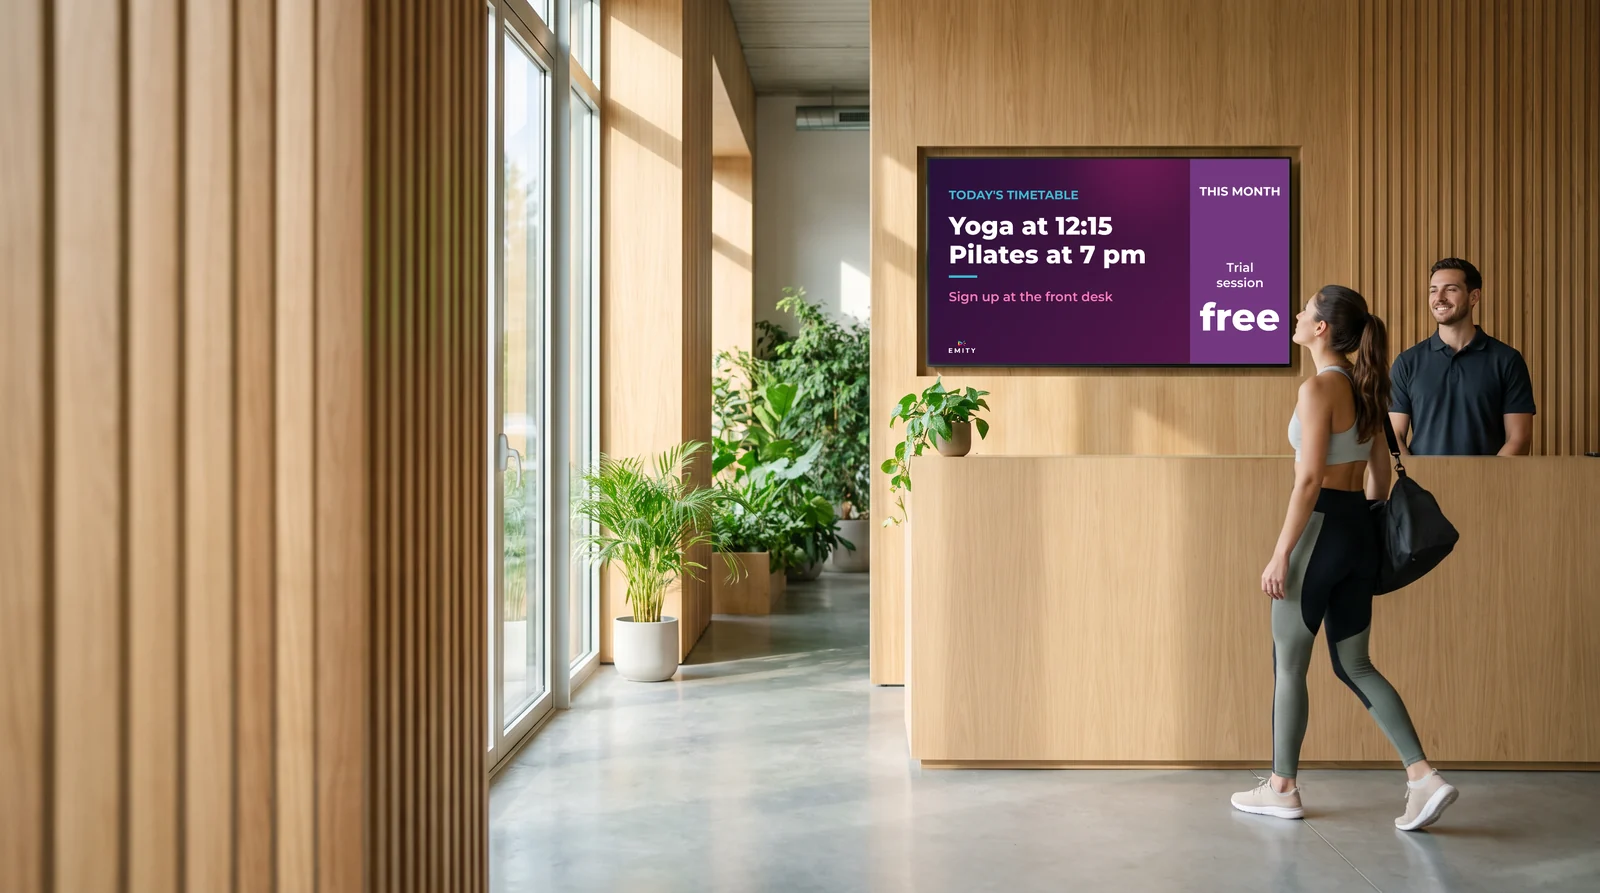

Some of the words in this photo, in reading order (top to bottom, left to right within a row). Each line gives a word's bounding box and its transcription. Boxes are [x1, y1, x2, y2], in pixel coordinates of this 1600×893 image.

[948, 190, 1003, 200] TODAY'S
[1007, 190, 1078, 200] TIMETABLE
[1199, 186, 1228, 197] THIS
[1232, 186, 1281, 197] MONTH
[948, 217, 1013, 240] Yoga
[1022, 217, 1048, 236] at
[1055, 217, 1113, 236] 12:15
[949, 243, 1039, 265] Pilates
[1046, 247, 1073, 265] at
[1080, 246, 1096, 264] 7
[1103, 249, 1146, 269] pm
[1226, 262, 1254, 273] Trial
[1216, 277, 1264, 288] session
[948, 291, 978, 304] Sign
[982, 293, 999, 304] up
[1003, 292, 1016, 302] at
[1020, 291, 1042, 302] the
[1045, 291, 1078, 302] front
[1082, 291, 1113, 302] desk
[1200, 302, 1280, 331] free
